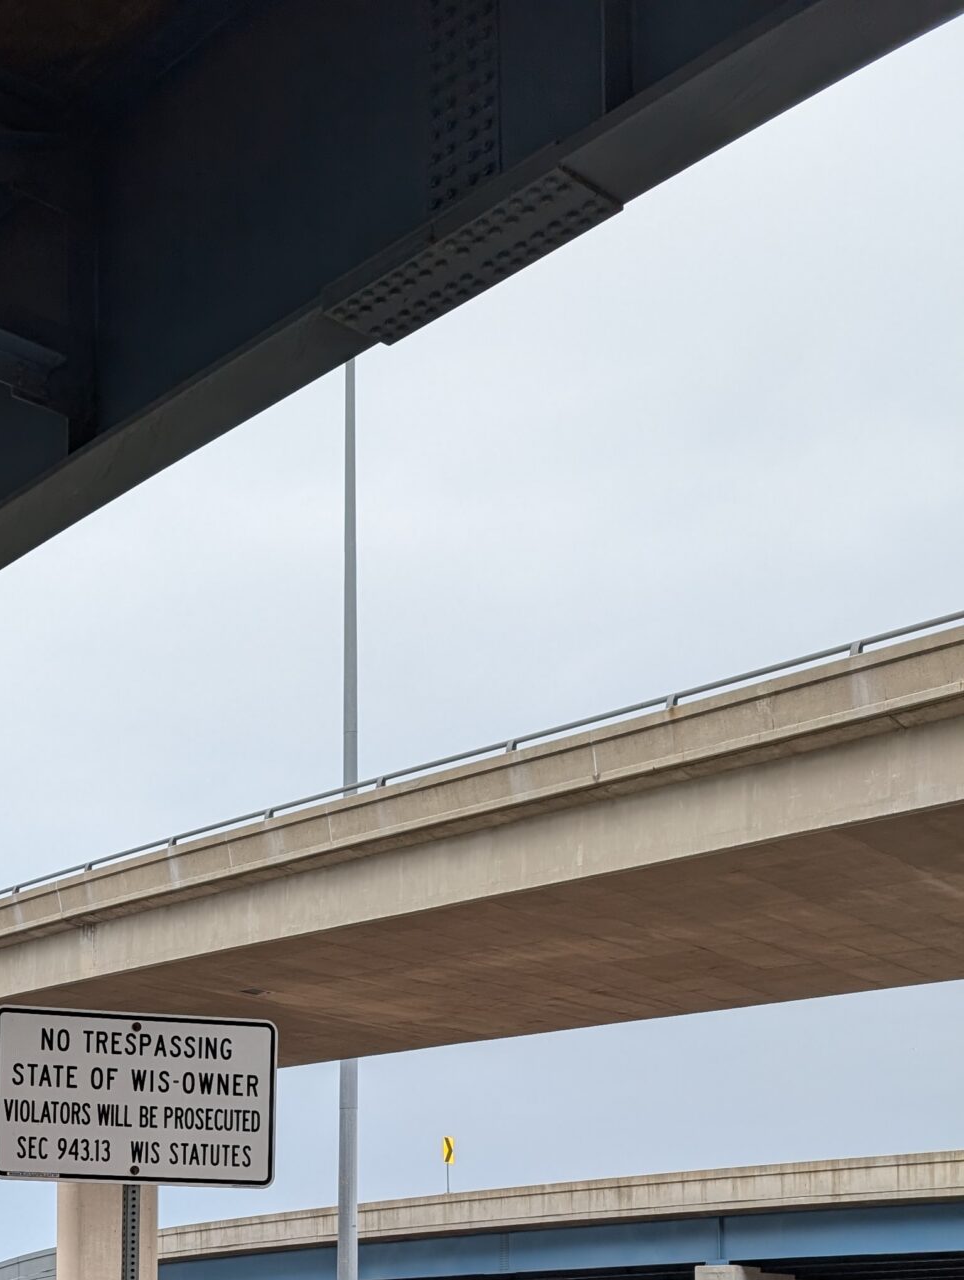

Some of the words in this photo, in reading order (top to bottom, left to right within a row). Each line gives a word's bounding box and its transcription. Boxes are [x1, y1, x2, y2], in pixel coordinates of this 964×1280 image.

[41, 1028, 70, 1051] NO
[83, 1030, 232, 1060] TRESPASSING
[12, 1063, 78, 1088] STATE
[91, 1067, 118, 1090] OF
[131, 1069, 259, 1097] WIS-OWNER
[4, 1099, 91, 1125] VIOLATORS
[98, 1103, 132, 1127] WILL
[139, 1106, 158, 1128] BE
[164, 1107, 260, 1133] PROSECUTED
[17, 1136, 48, 1159] SEC
[58, 1138, 110, 1162] 943.13
[131, 1141, 160, 1164] WIS
[169, 1143, 251, 1167] STATUTES
